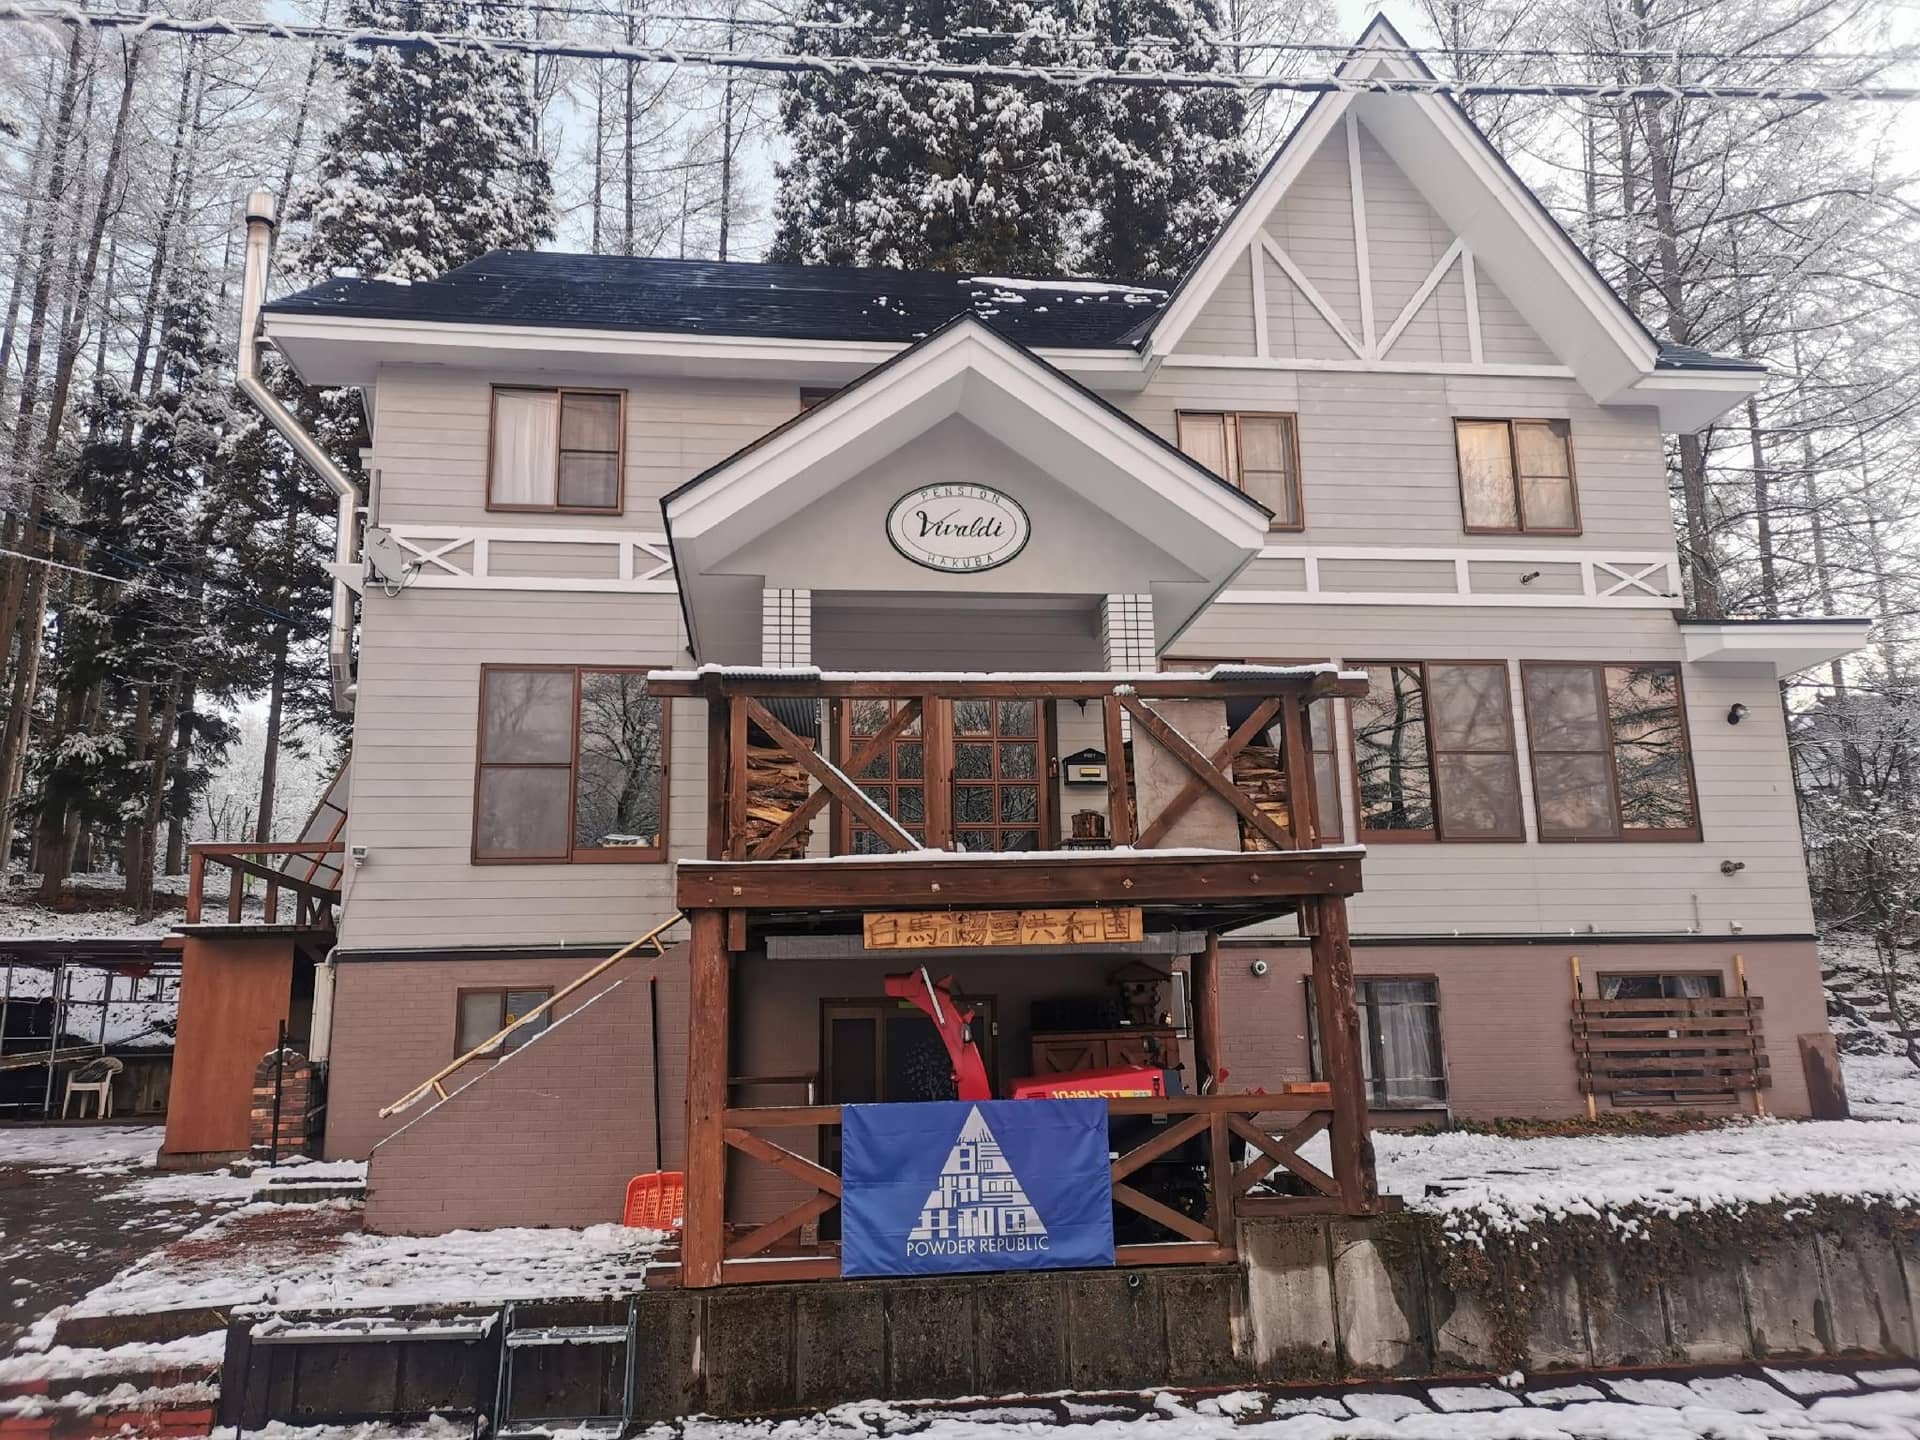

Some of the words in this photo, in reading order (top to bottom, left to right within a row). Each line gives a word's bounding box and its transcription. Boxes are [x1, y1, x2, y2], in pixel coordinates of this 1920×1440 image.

[919, 486, 1001, 505] PENSION
[916, 508, 1006, 538] Vivaldi
[927, 552, 994, 569] HAKUBA
[906, 1239, 976, 1257] POWDER
[979, 1236, 1050, 1254] REPUBLIC
